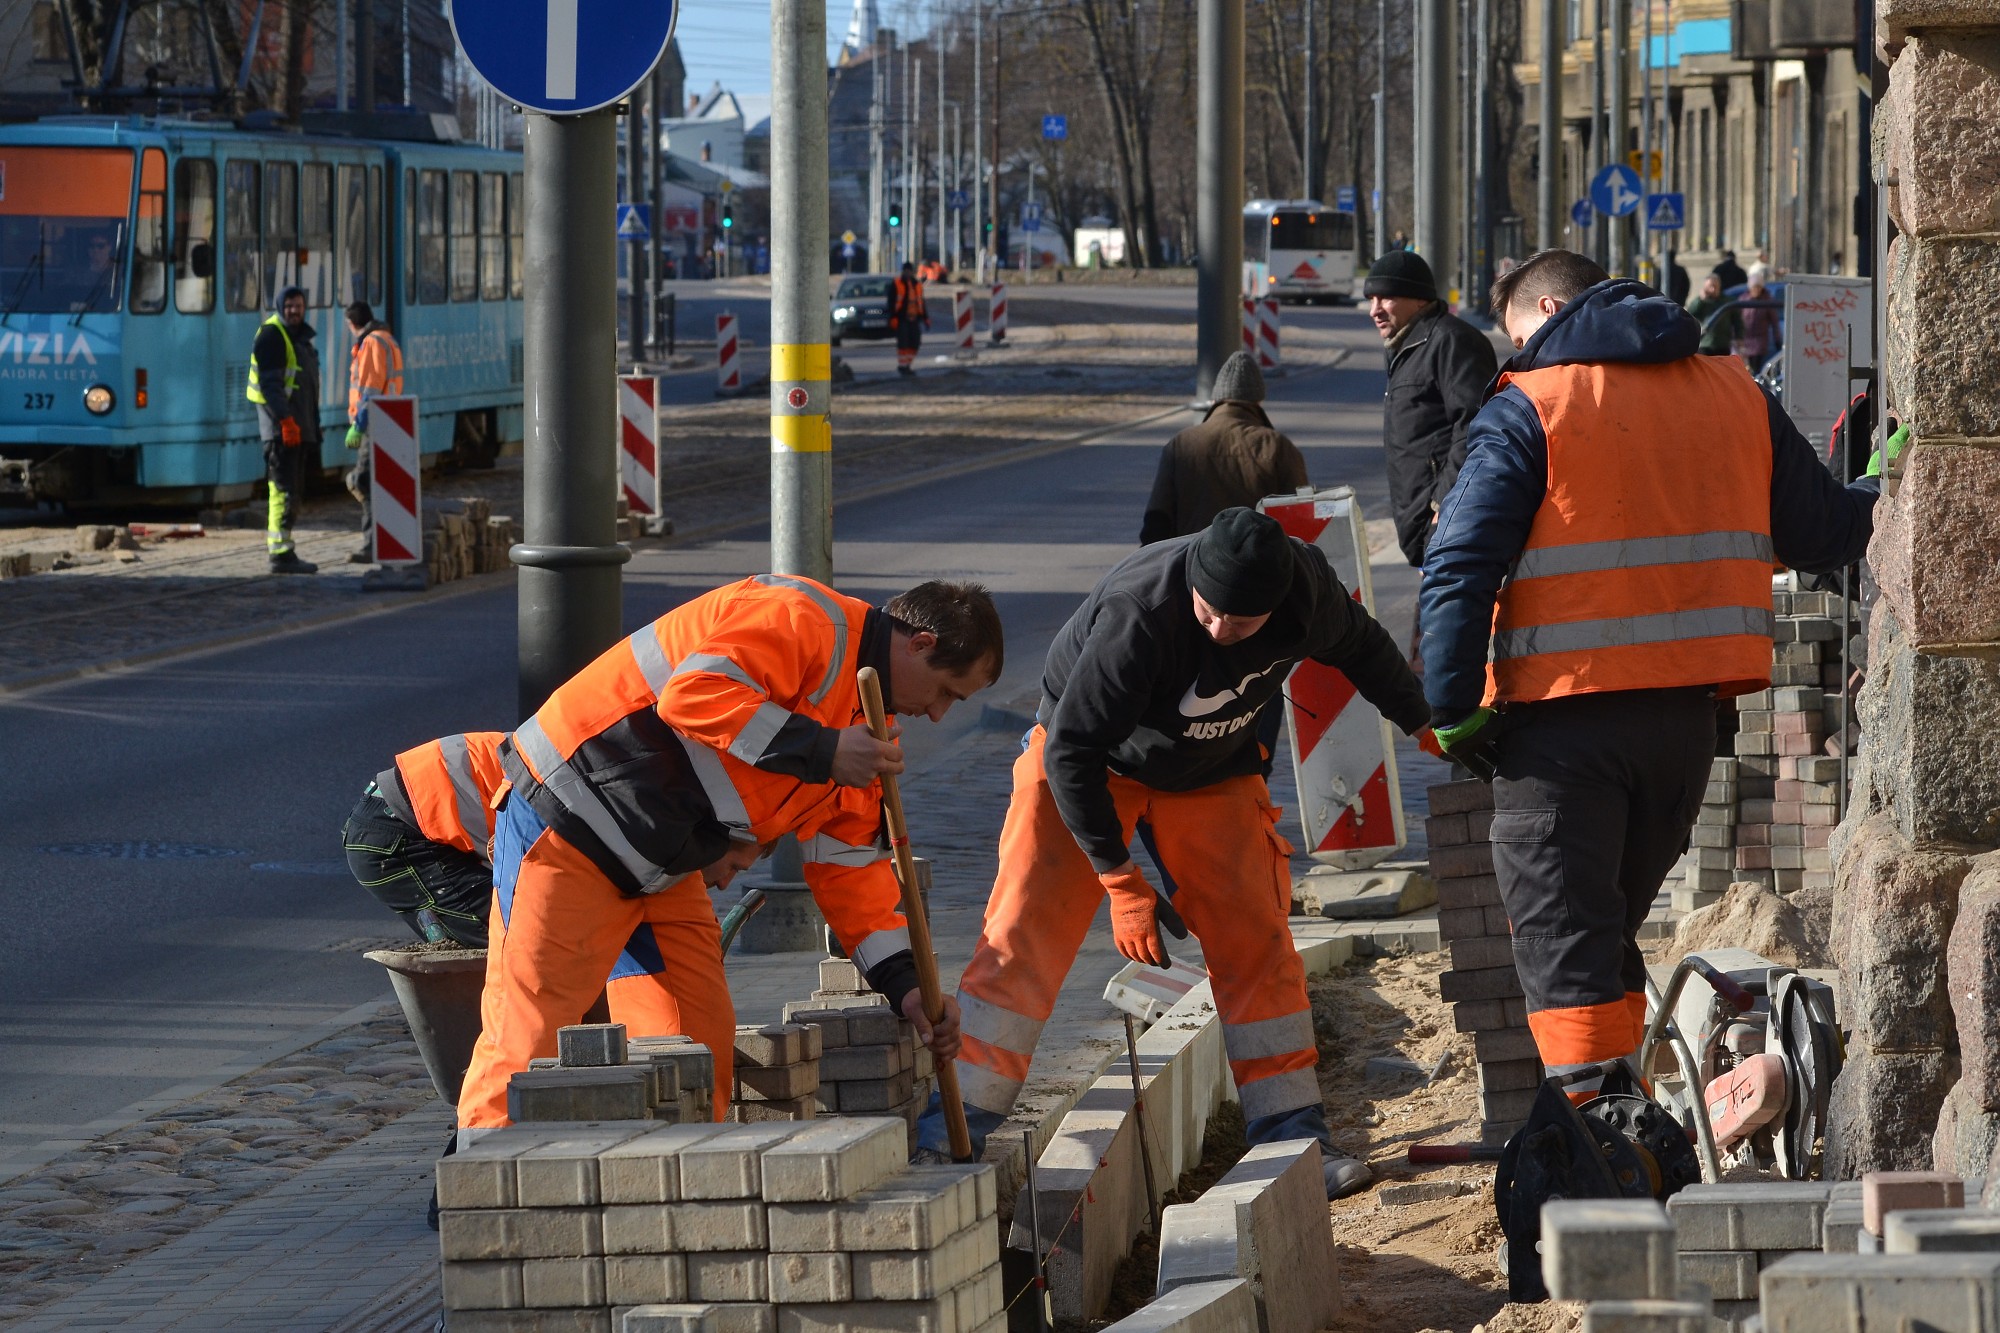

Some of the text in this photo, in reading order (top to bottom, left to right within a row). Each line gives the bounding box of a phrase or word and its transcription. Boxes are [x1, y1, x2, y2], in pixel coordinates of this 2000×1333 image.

[54, 369, 98, 380] LIETA
[24, 393, 55, 410] 237
[1182, 711, 1252, 739] JUST DO
